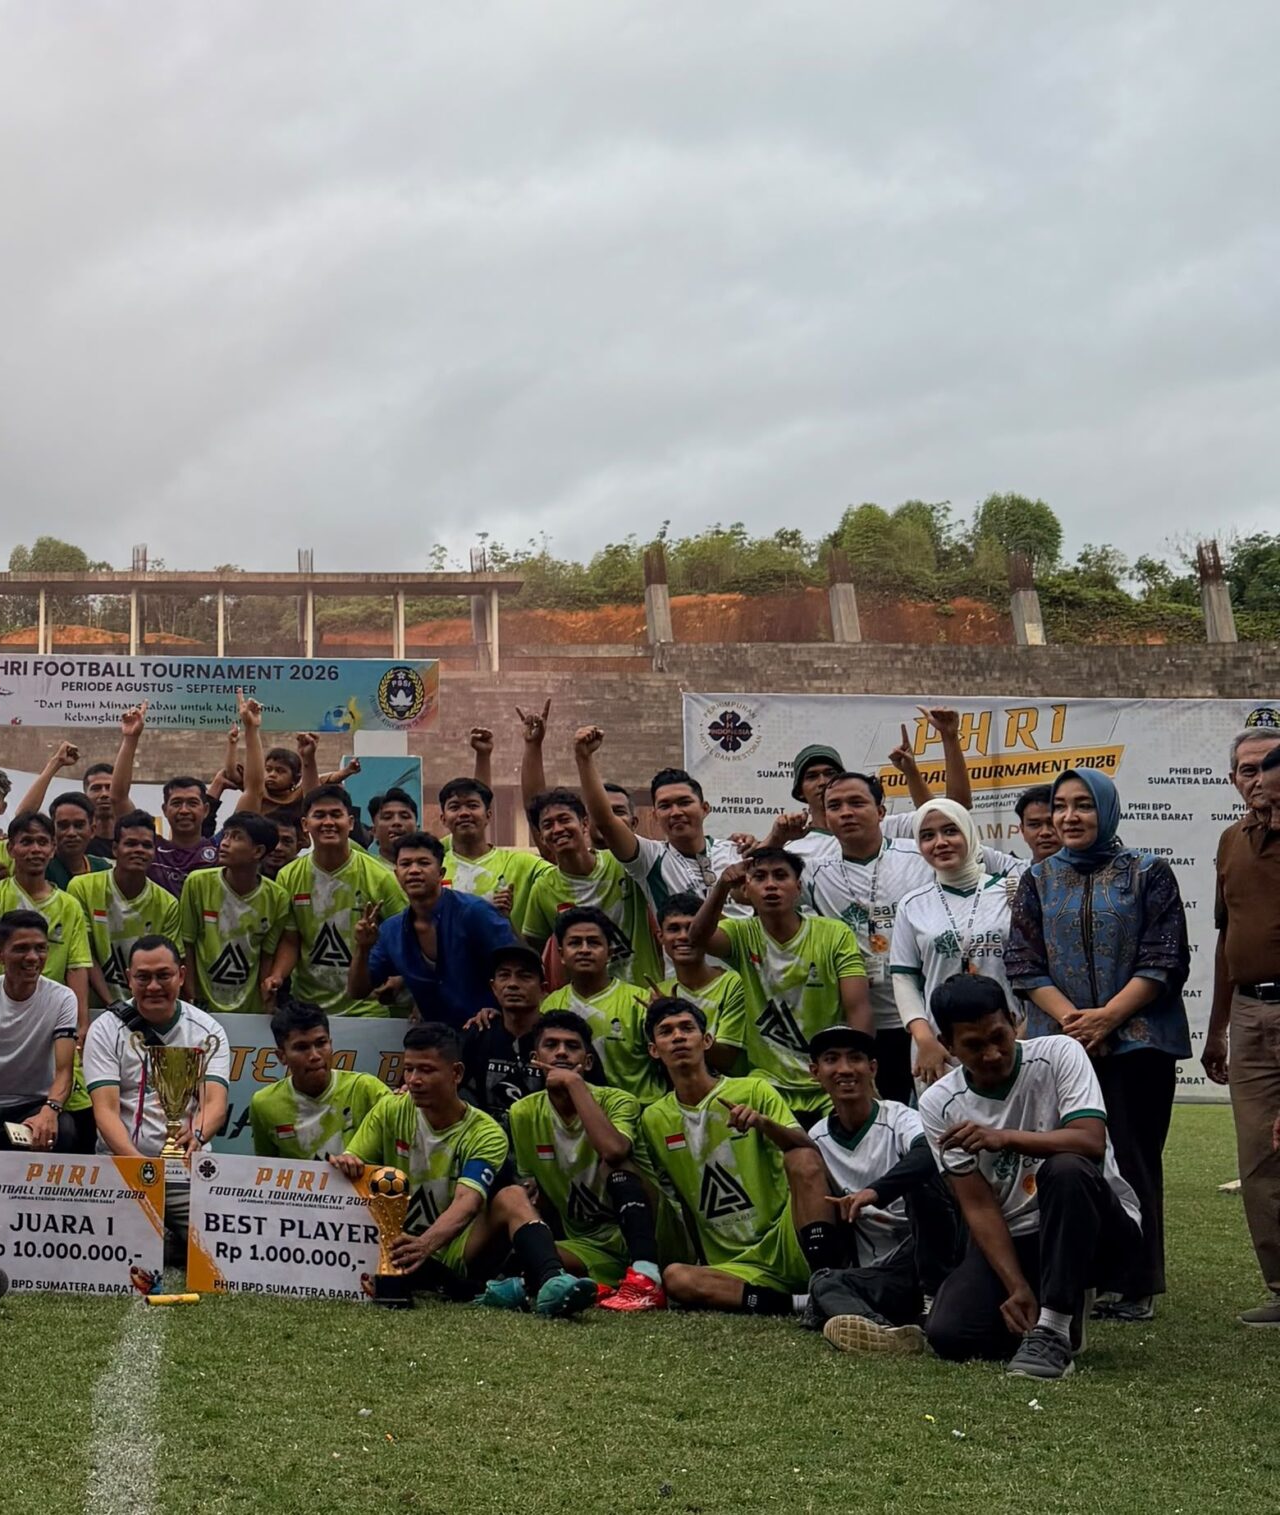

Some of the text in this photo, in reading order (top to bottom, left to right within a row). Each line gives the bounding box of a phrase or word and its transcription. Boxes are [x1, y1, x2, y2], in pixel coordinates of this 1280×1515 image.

[33, 661, 135, 677] FOOTBALL
[140, 662, 284, 680] TOURNAMENT
[289, 664, 339, 681] 2026
[61, 681, 112, 692] PERIODE
[115, 682, 174, 693] AGUSTUS
[186, 683, 257, 695] SEPTEMBER
[99, 701, 176, 711] Minangabau
[181, 701, 213, 711] untuk
[216, 702, 239, 713] Mej
[64, 712, 122, 725] Kebangkit
[145, 713, 196, 725] ospitality
[967, 758, 1071, 783] OURNAMENT
[1074, 754, 1116, 769] 2026
[1169, 767, 1213, 775] PHRI BPD
[1147, 777, 1200, 785] SUMATERA
[721, 796, 763, 805] PHRI BPD
[1152, 803, 1171, 811] BPD
[709, 806, 785, 815] UMATERA BARAT
[1120, 813, 1194, 821] MATERA BARAT
[1154, 848, 1174, 856] BPD
[1169, 857, 1196, 866] ARAT
[873, 902, 898, 916] saf
[969, 946, 1003, 958] care
[25, 1162, 101, 1187] PHRI
[255, 1167, 330, 1192] PHRI
[38, 1186, 115, 1199] TOURNAMENT
[209, 1186, 265, 1199] FOOTBALL
[267, 1190, 345, 1205] TOURNAMENT
[10, 1212, 95, 1236] JUARA
[204, 1213, 379, 1245] BEST PLAYER
[13, 1241, 142, 1266] 10.000.000,-
[215, 1242, 366, 1272] Rp 1.000.000,-
[11, 1279, 134, 1294] BPD SUMATERA BARAT
[214, 1279, 365, 1300] PHRI BPD SUMATERA BARAT
